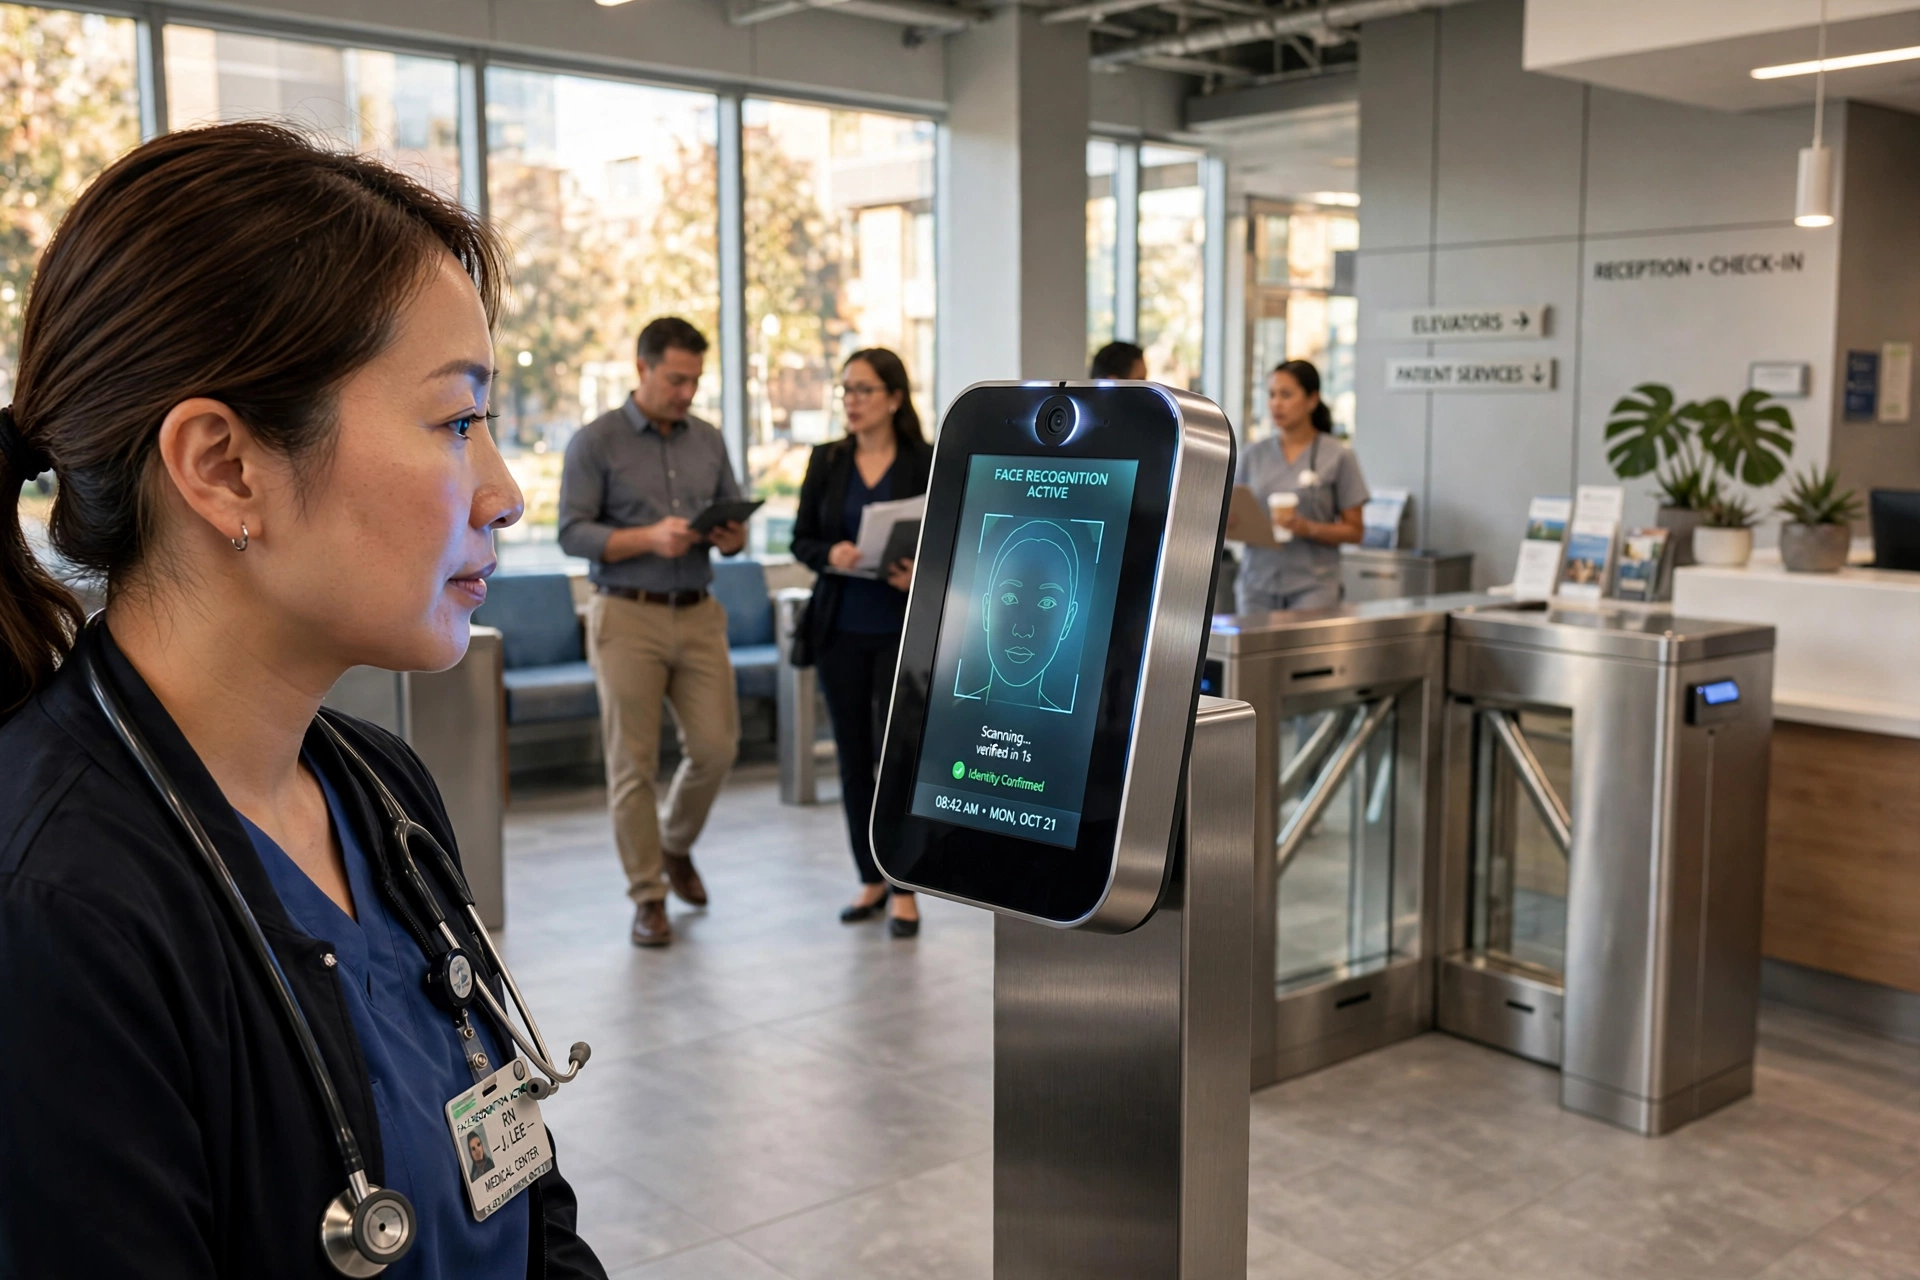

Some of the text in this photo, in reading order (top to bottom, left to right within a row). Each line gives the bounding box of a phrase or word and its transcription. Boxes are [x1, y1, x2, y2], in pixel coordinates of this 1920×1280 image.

[1594, 253, 1805, 281] RECEPTION CHECK-IN
[1412, 313, 1503, 335] ELEVATORS
[1396, 362, 1524, 383] PATIENT SERVICES
[994, 468, 1109, 485] FACE RECOGNITION
[1026, 486, 1069, 499] ACTIVE
[980, 725, 1031, 747] Scanning...
[976, 743, 1032, 763] verified in 1s
[968, 768, 1045, 792] Identity Confirmed
[935, 794, 1057, 831] 08:42 AM MON, OCT 21
[502, 1107, 516, 1128] RN
[510, 1122, 527, 1146] LEE
[484, 1164, 515, 1193] MEDICAL
[514, 1145, 540, 1172] CENTER
